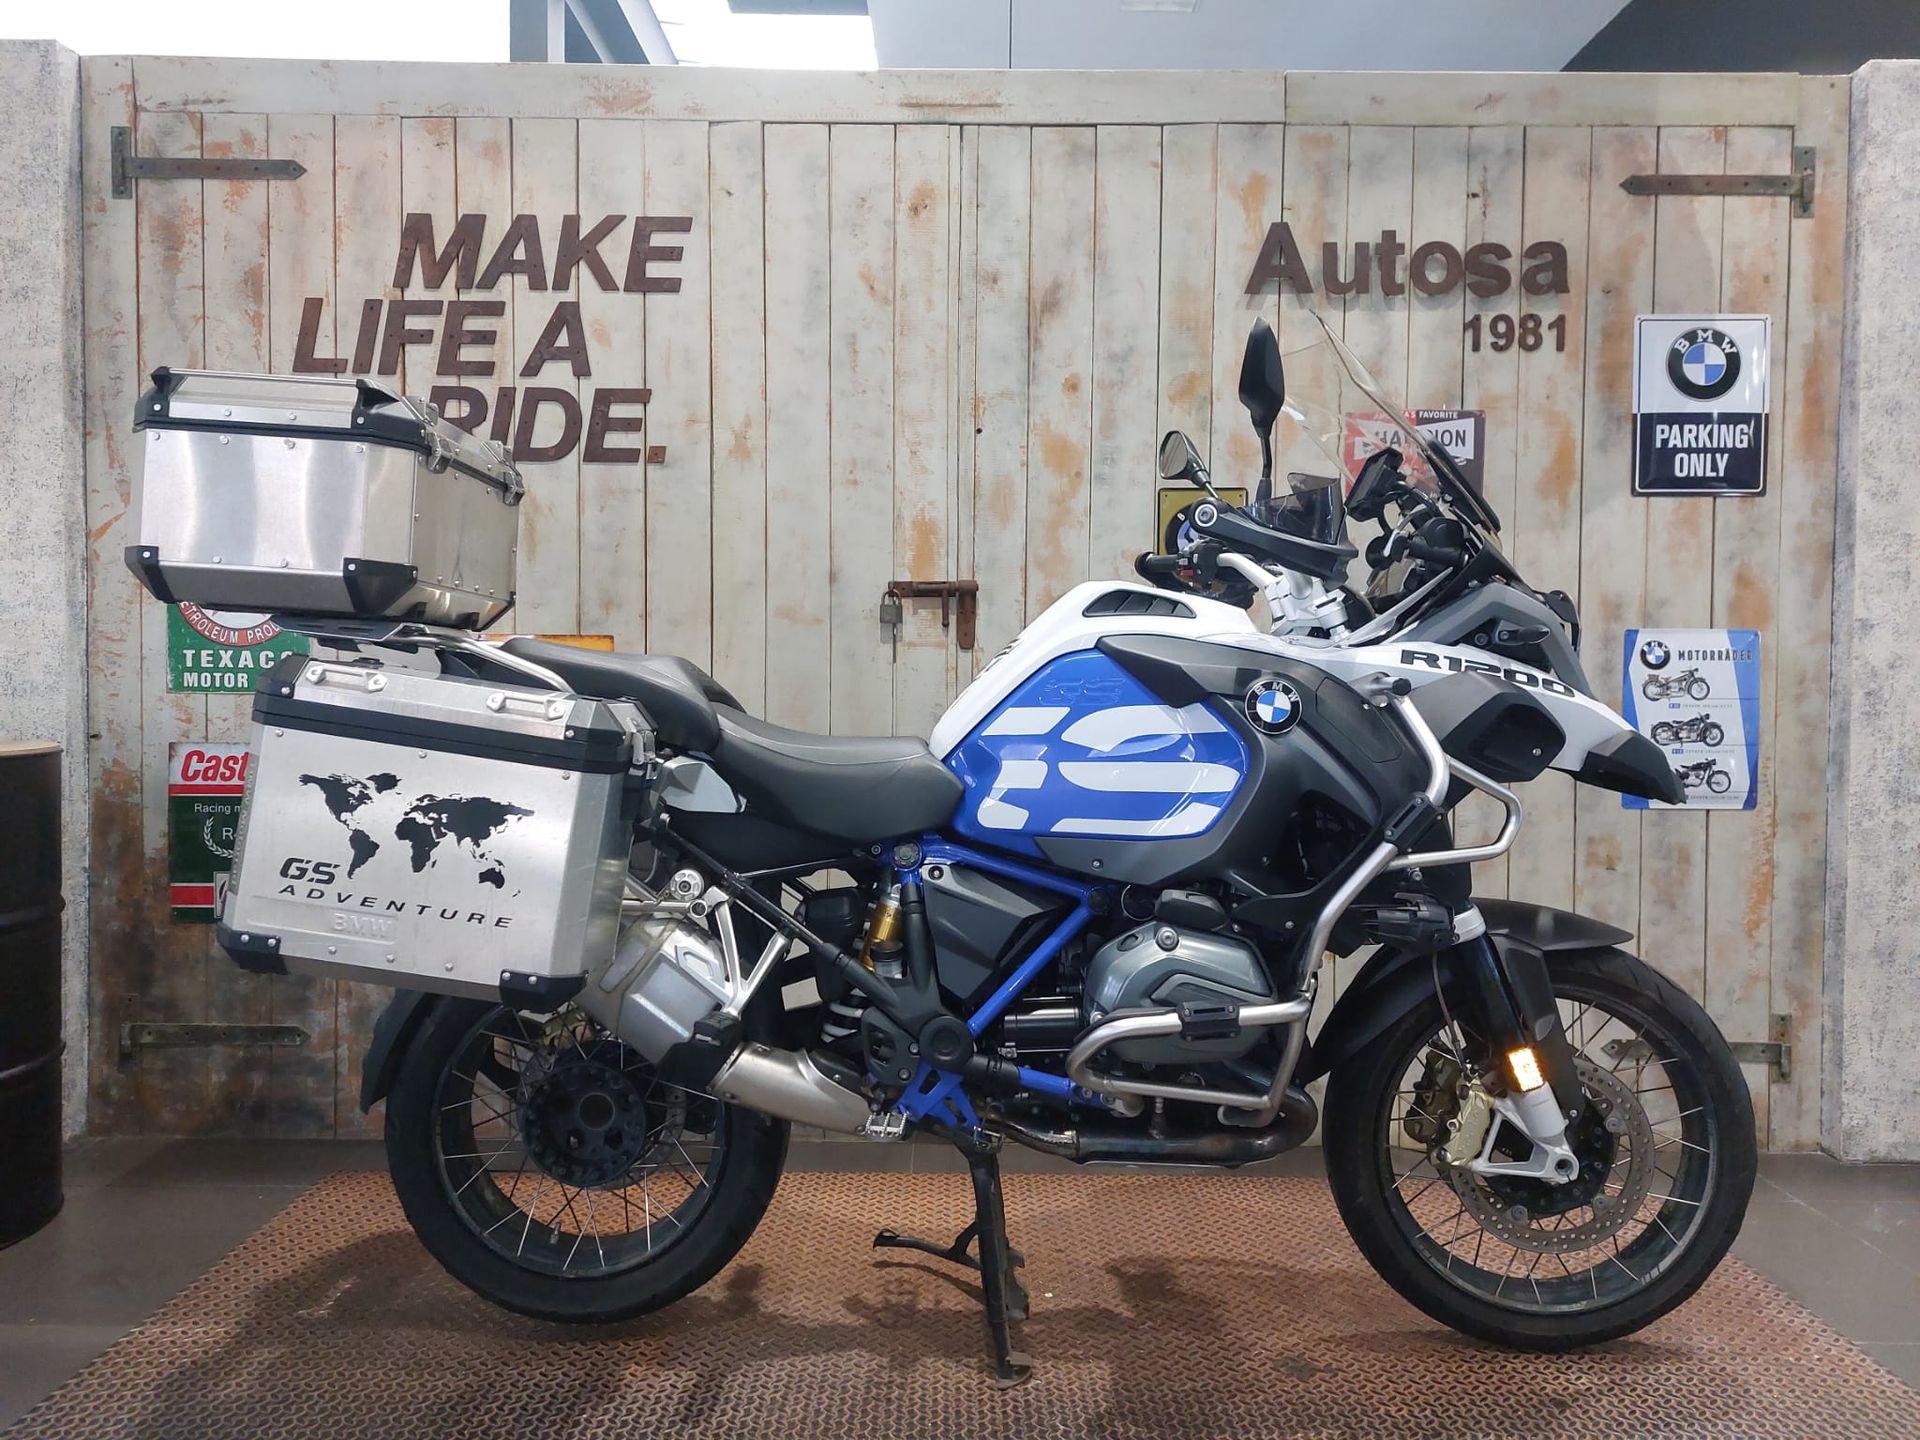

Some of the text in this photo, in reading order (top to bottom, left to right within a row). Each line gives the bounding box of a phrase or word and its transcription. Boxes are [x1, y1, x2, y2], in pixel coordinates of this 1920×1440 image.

[392, 213, 694, 292] MAKE
[1244, 222, 1570, 297] Autosa
[292, 297, 592, 376] LIFE A
[1463, 313, 1567, 352] 1981
[1674, 329, 1737, 354] BMW
[1419, 410, 1459, 419] FAVORITE
[1655, 424, 1749, 448] PARKING
[1674, 453, 1729, 477] ONLY
[182, 649, 293, 669] TEXAC
[183, 672, 249, 688] MOTOR
[1400, 649, 1576, 698] R1200
[1253, 682, 1300, 702] BMW
[194, 803, 231, 815] Racing
[279, 857, 341, 885] GS
[278, 884, 513, 928] ADVENTURE
[333, 912, 393, 937] BMW
